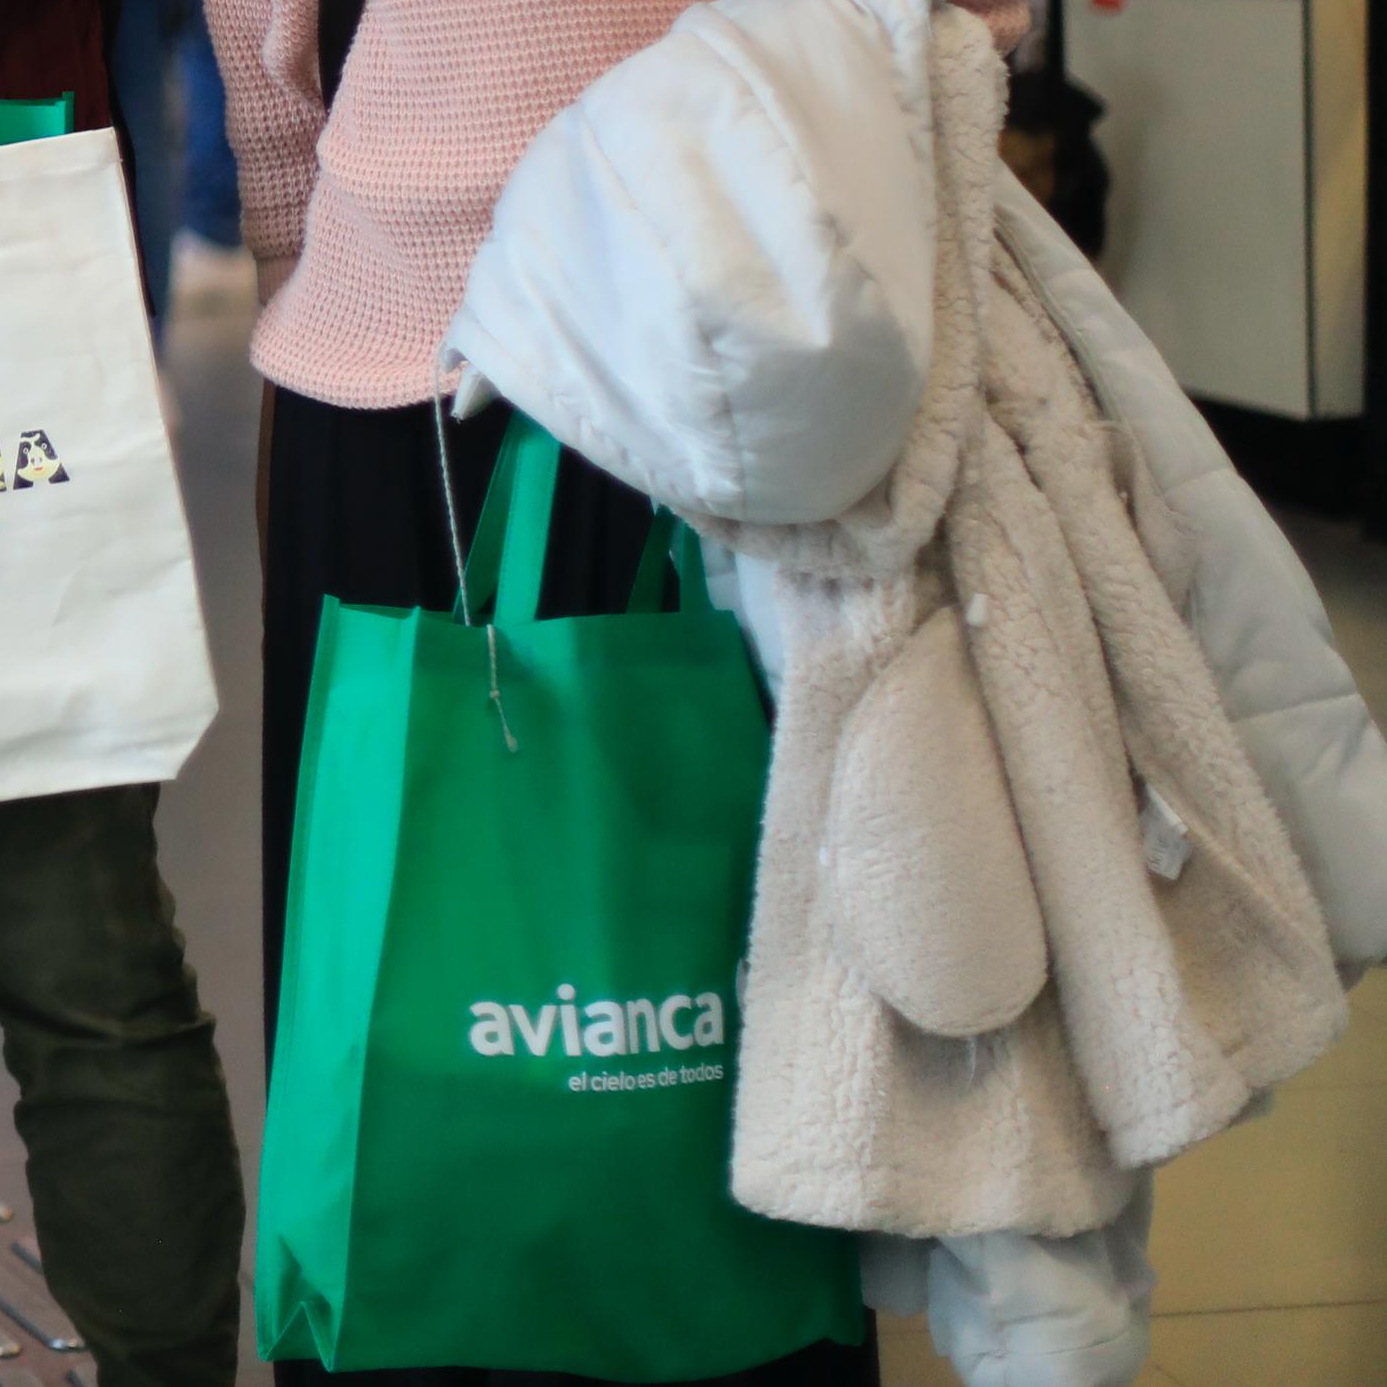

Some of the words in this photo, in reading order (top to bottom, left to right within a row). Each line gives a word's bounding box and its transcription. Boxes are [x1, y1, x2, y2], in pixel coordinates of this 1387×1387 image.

[468, 983, 725, 1057] avianca
[568, 1071, 588, 1091] el
[590, 1071, 636, 1092] cielo
[637, 1072, 656, 1089] es
[658, 1067, 678, 1087] de
[679, 1063, 724, 1084] todos
